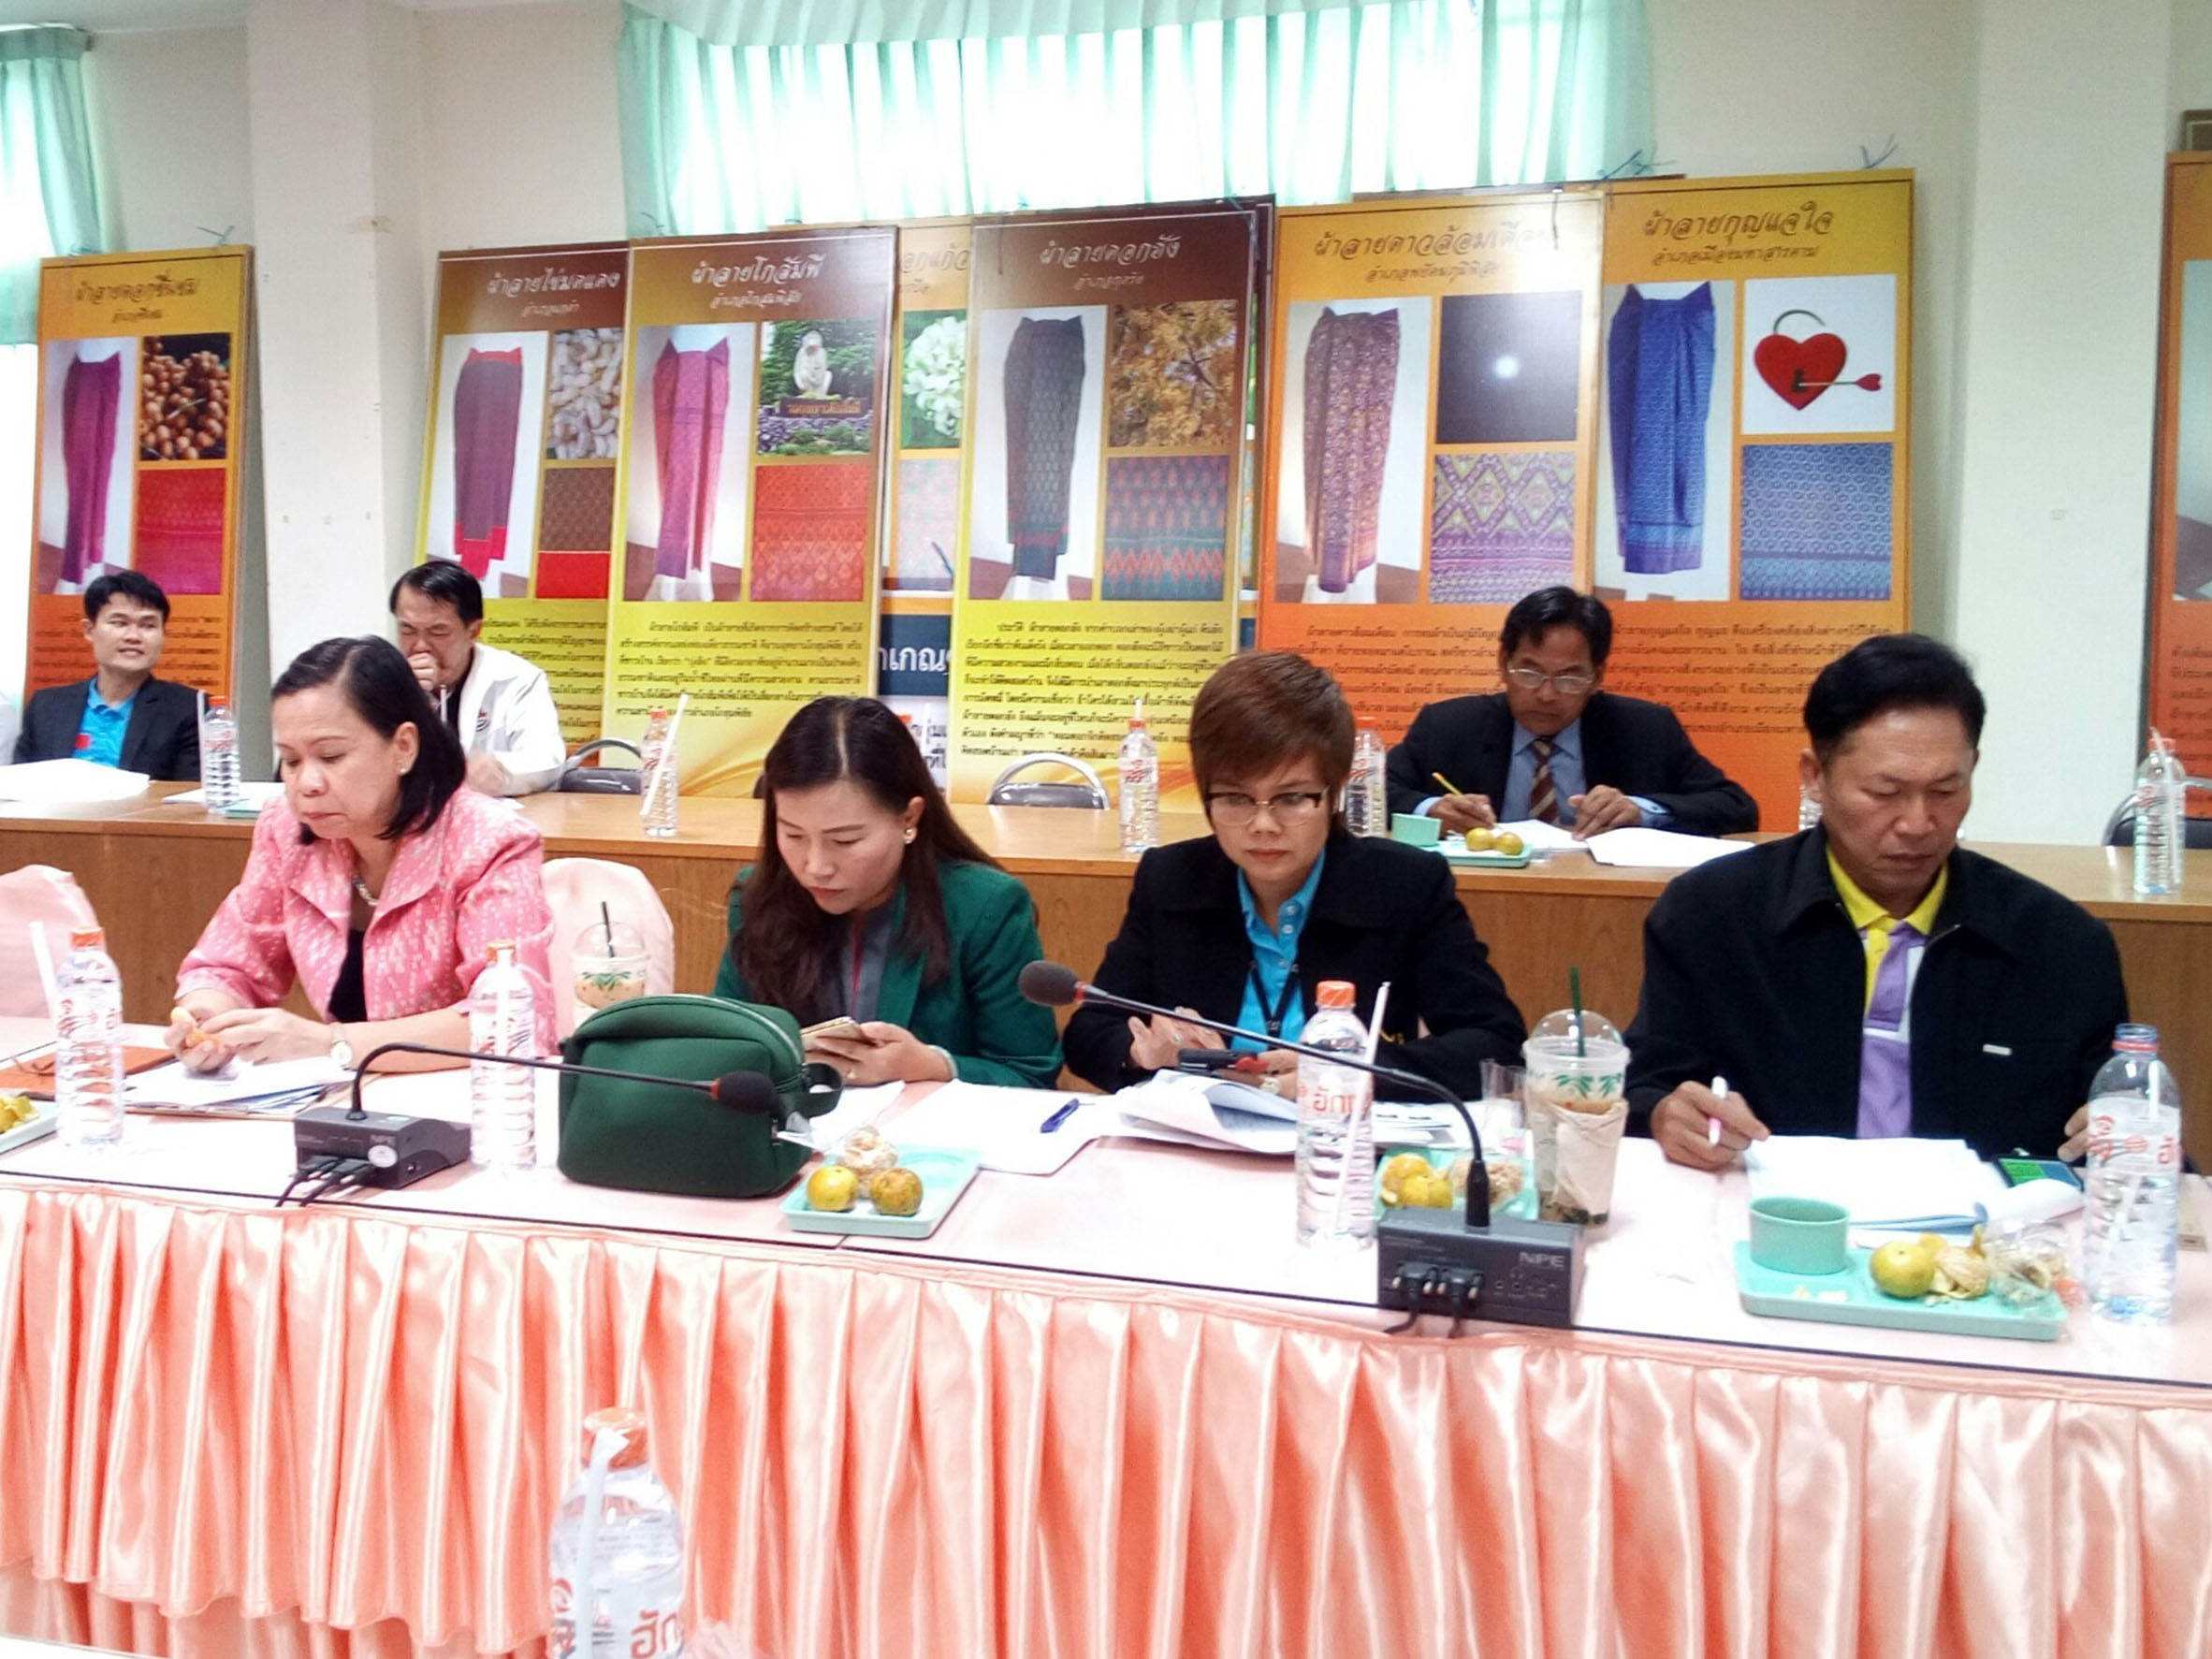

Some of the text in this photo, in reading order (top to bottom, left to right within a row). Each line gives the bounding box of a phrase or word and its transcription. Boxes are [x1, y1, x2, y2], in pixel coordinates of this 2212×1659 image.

[1643, 200, 1834, 245] ผ้าลายกุญแจใจ
[1519, 1251, 1565, 1268] NPE
